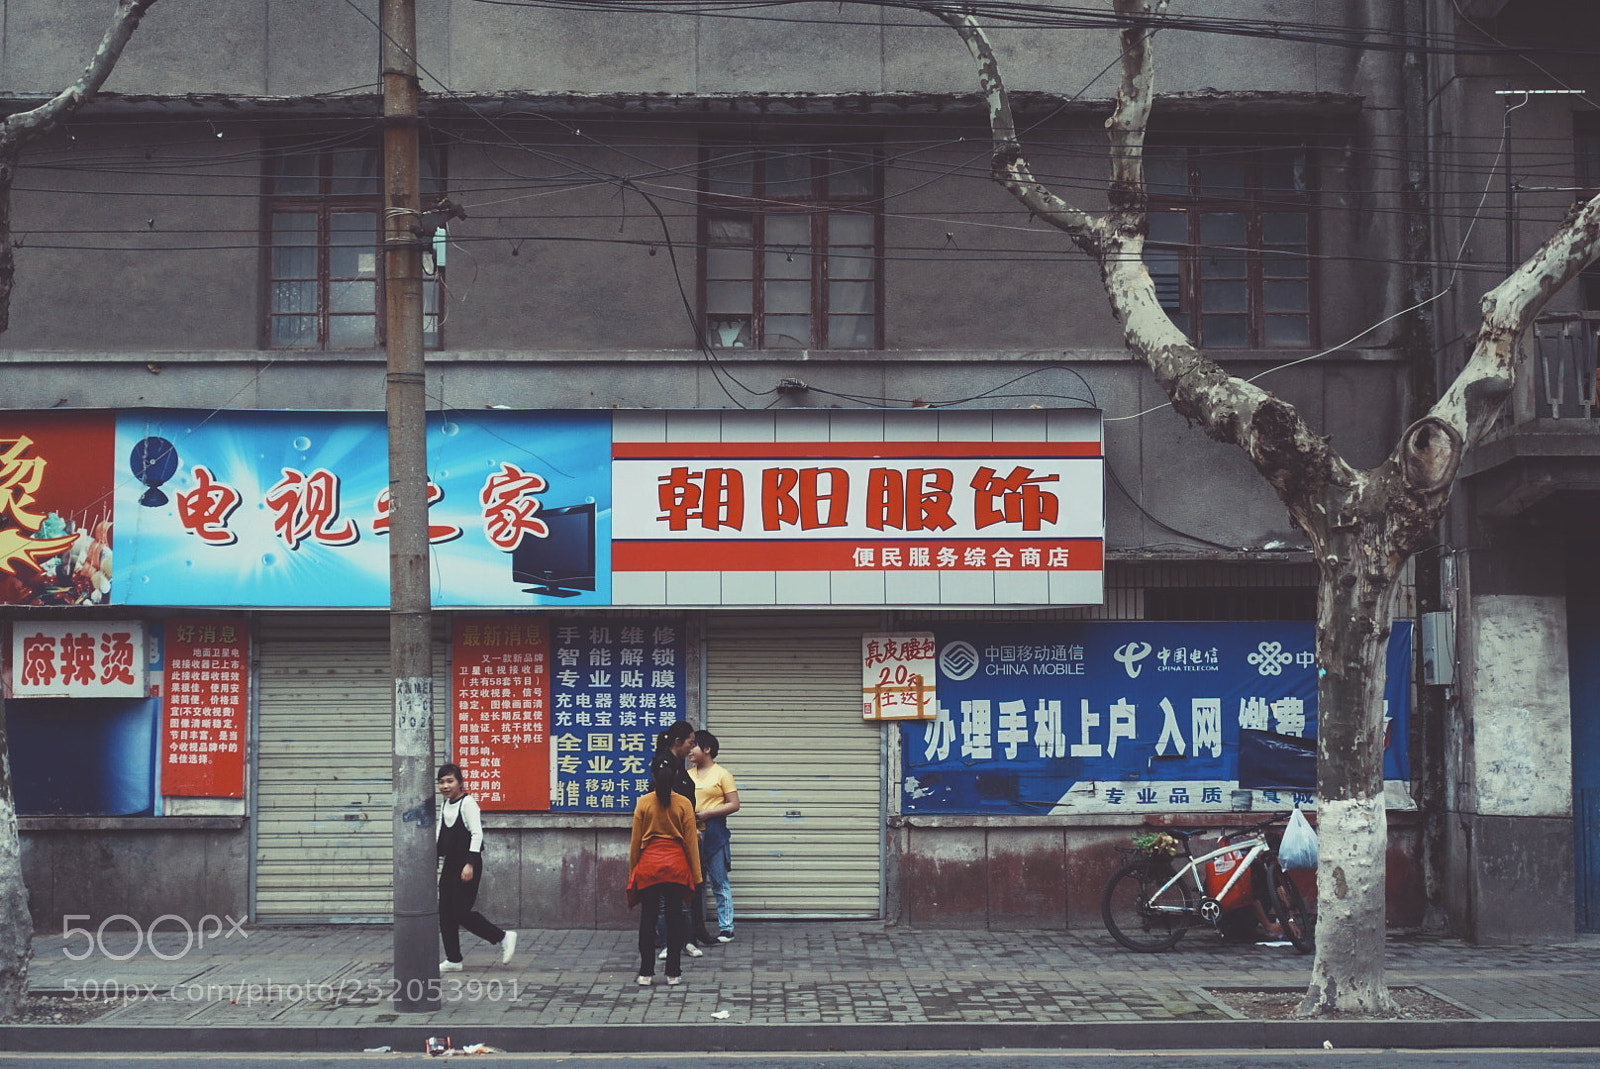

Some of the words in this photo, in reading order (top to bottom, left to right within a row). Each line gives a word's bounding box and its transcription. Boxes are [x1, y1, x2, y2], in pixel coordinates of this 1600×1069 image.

[657, 465, 1060, 532] 朝阳服饰
[852, 547, 1070, 567] 便民服务综合商店
[177, 625, 237, 644] 好消息
[463, 625, 542, 647] 最新消息
[557, 626, 675, 645] 手机维修
[21, 632, 135, 686] 麻辣烫
[193, 648, 240, 658] 地面卫星电
[481, 653, 544, 663] 又一款新品牌
[557, 648, 675, 667] 智能解锁
[985, 644, 1084, 662] 中国移动通信
[1157, 646, 1219, 666] 中国电信
[171, 671, 240, 682] 此接收器收视效
[459, 665, 544, 675] 卫星电视接收器
[985, 663, 1028, 676] CHINA
[1033, 663, 1085, 675] MOBILE
[556, 669, 675, 688] 专业贴膜
[555, 693, 613, 709] 充电器
[619, 693, 677, 709] 数据线
[555, 711, 613, 727] 充电宝
[619, 711, 677, 727] 读卡器
[923, 698, 1136, 761] 办理手机上户
[1155, 697, 1222, 759] 入网
[169, 741, 238, 753] 今收视品牌中的
[459, 758, 501, 767] 是一款值
[557, 755, 653, 774] 专业充
[585, 779, 630, 793] 移动卡
[585, 795, 630, 808] 电信卡
[1105, 788, 1223, 805] 专业品质
